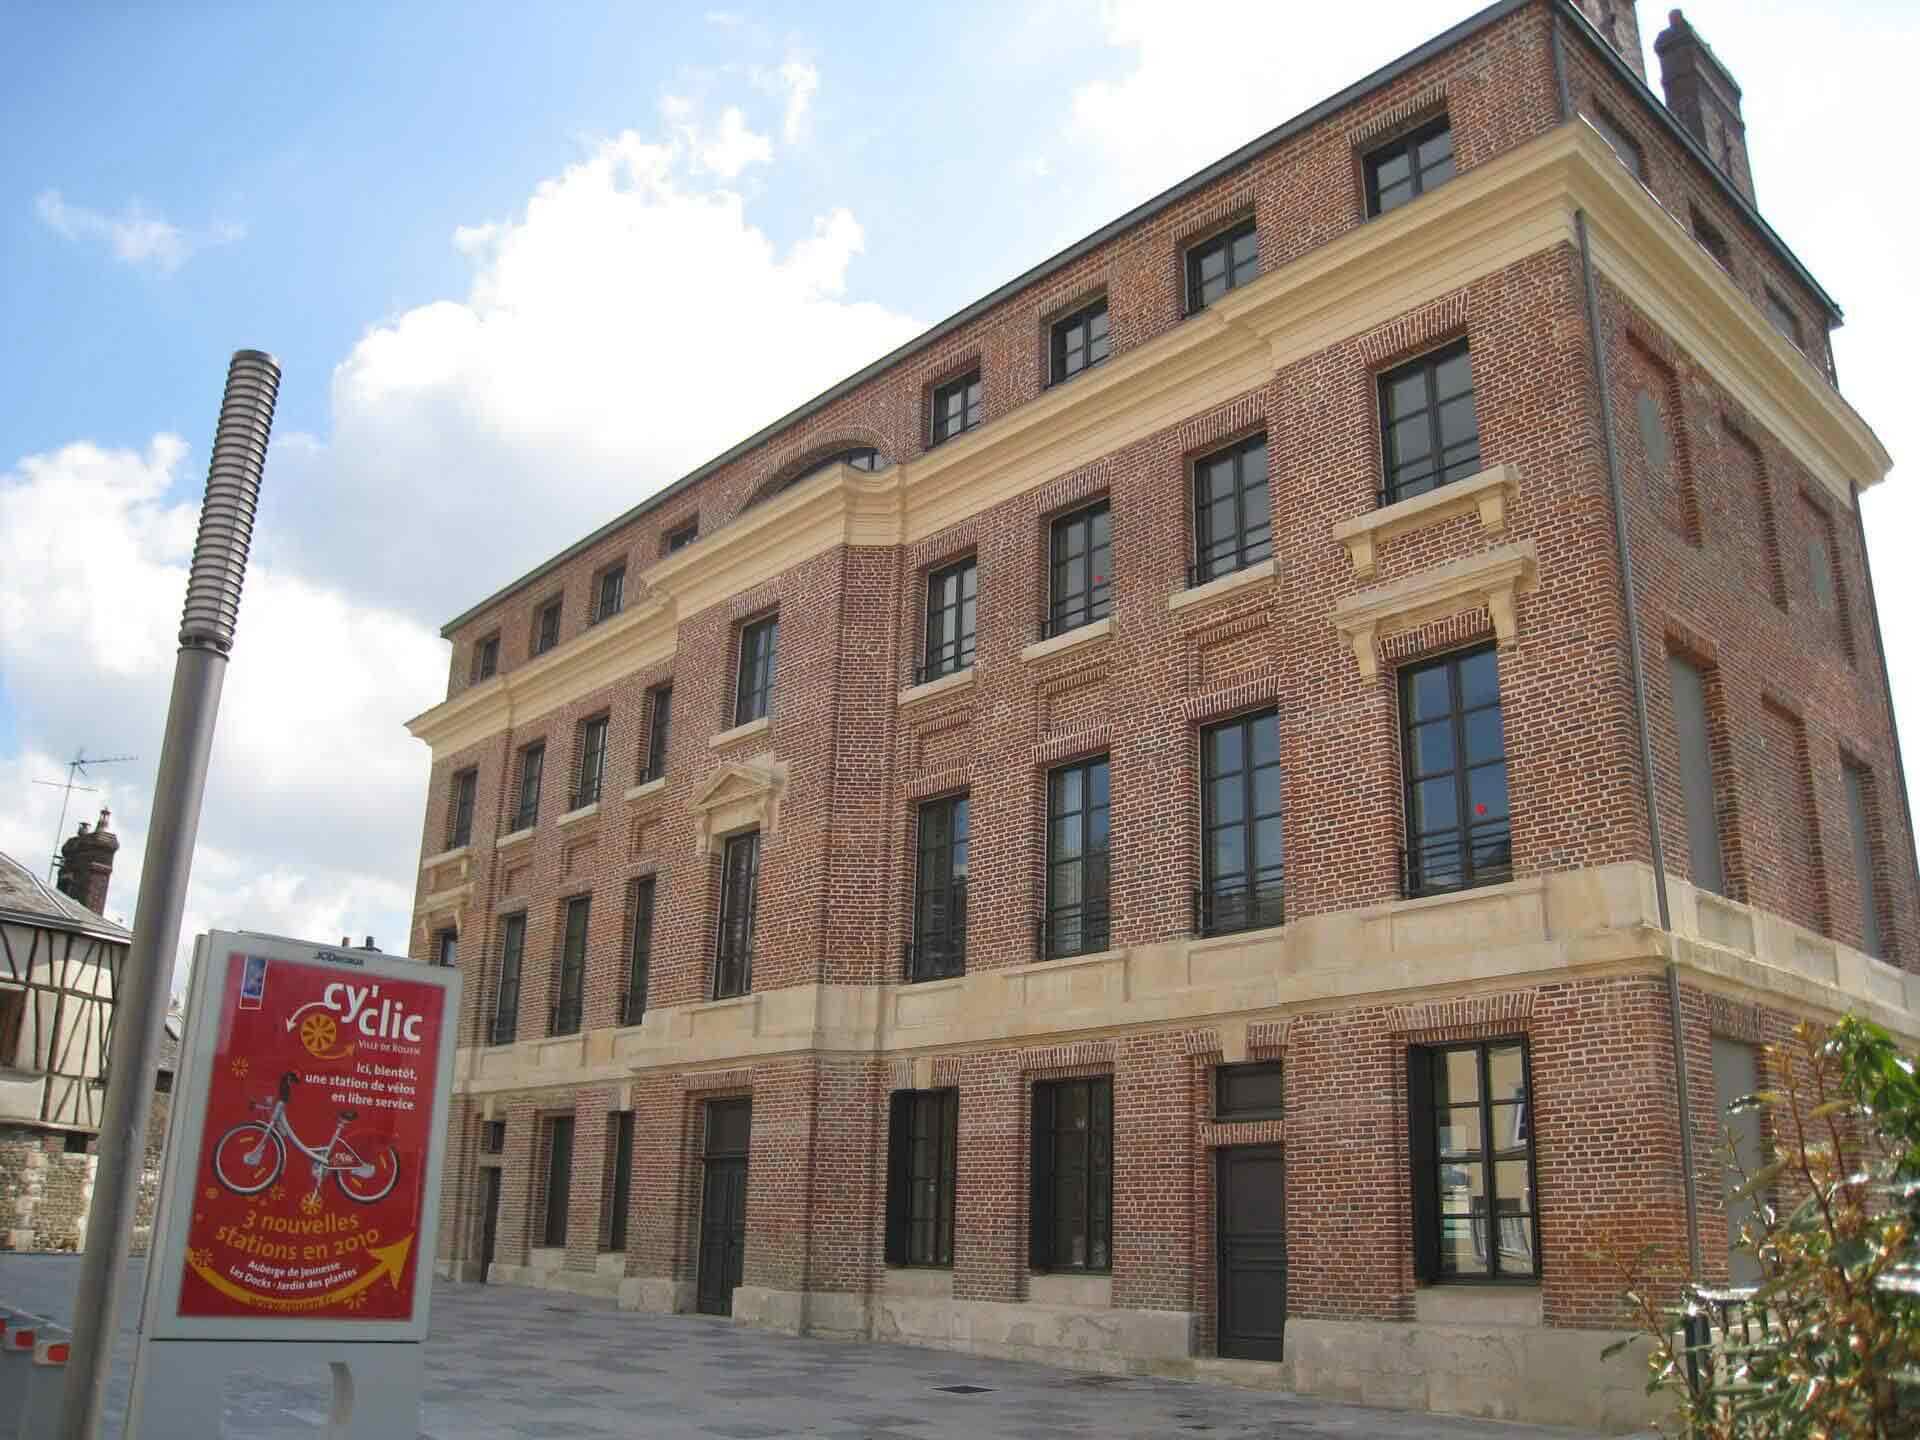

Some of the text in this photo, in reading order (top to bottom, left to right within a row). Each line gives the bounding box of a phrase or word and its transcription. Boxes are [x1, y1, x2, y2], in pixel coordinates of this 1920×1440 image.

[305, 1074, 416, 1095] une station de vélos
[331, 1092, 415, 1111] en libre service
[243, 1209, 360, 1234] 3 nouvelles
[216, 1225, 379, 1261] stations en 2010
[229, 1265, 244, 1279] Les
[324, 1268, 358, 1288] plantes
[287, 1267, 299, 1277] de
